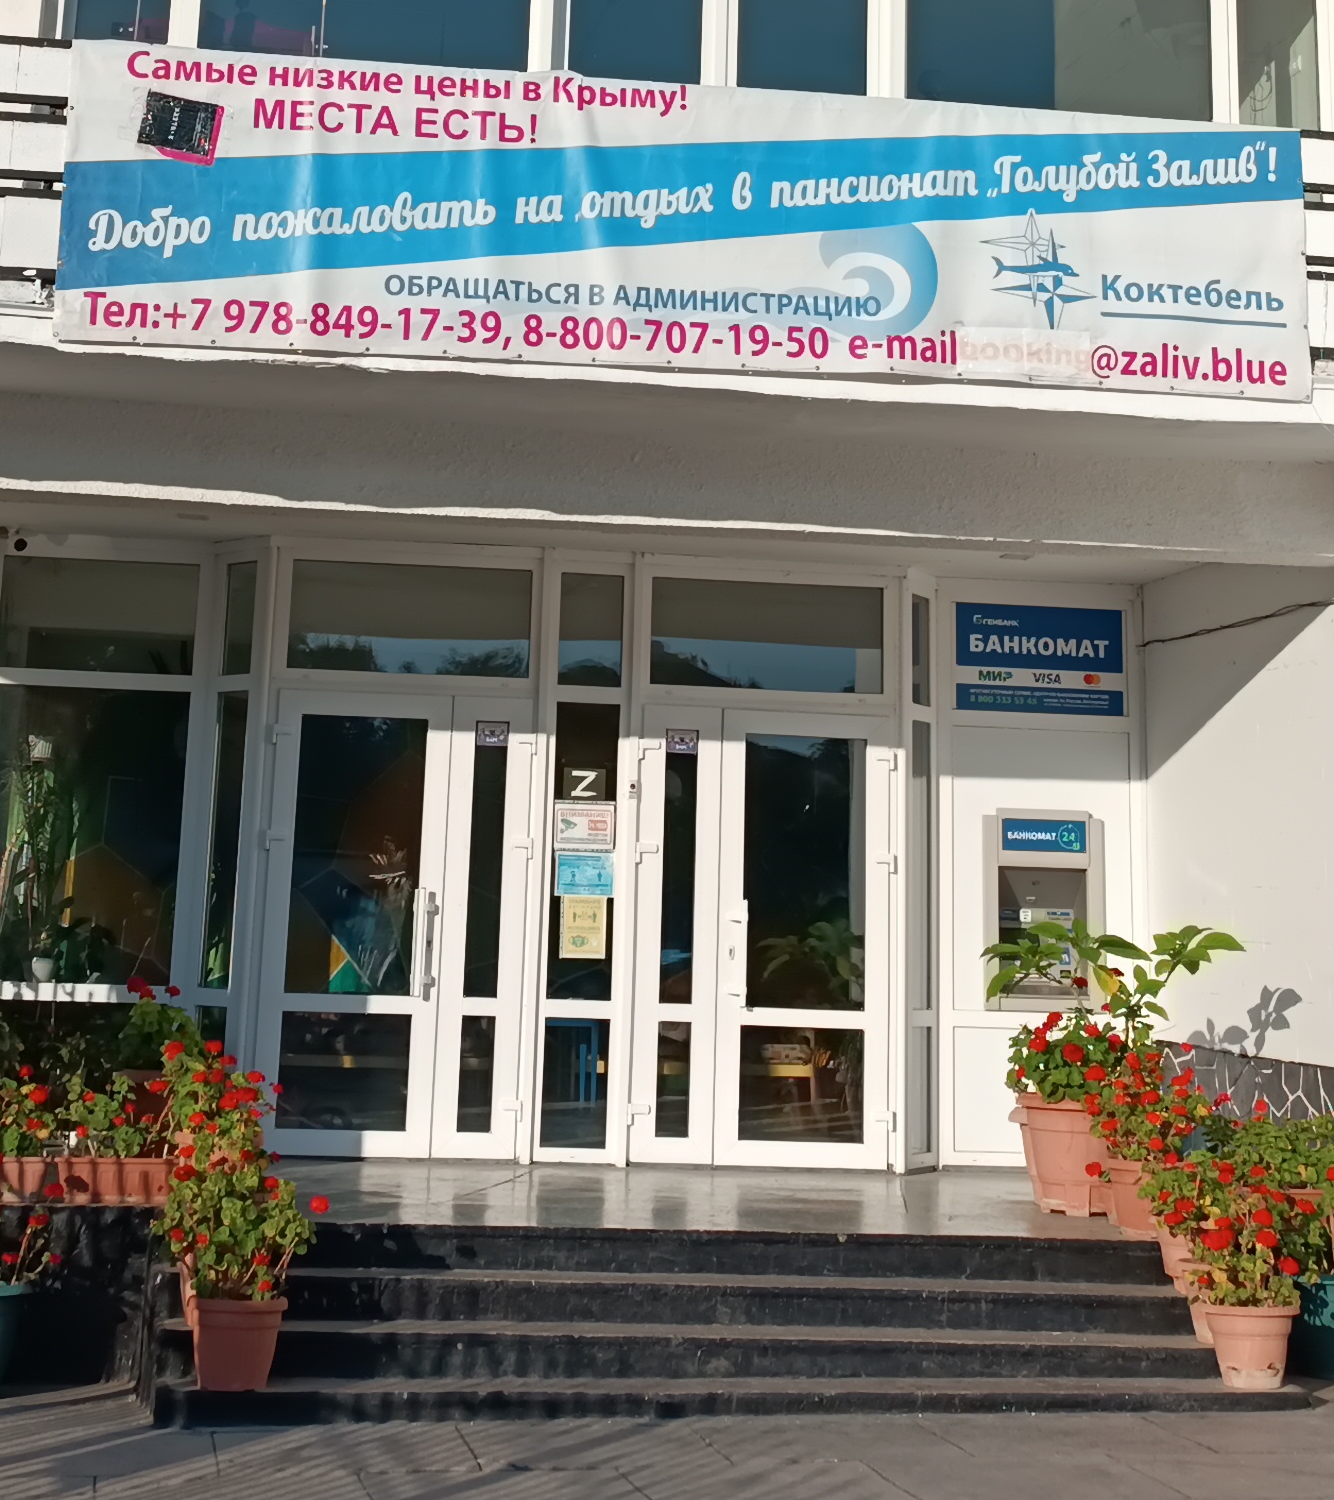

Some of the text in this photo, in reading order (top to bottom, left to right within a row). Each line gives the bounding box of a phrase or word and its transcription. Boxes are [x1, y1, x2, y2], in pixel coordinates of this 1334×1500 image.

[127, 51, 687, 116] Самые низкие цены в Крыму!
[254, 98, 538, 143] МЕСТА ЕСТЬ!
[88, 205, 211, 257] Добро
[233, 191, 496, 241] пожаловать
[515, 195, 563, 225] на
[580, 184, 713, 228] отдых
[731, 171, 753, 211] в
[771, 171, 978, 208] пансионат
[384, 274, 880, 319] ОБРАЩАТЬСЯ В АДМИНИСТРАЦИЮ
[1101, 274, 1284, 312] Коктебель
[84, 291, 213, 331] Тел:+7
[223, 300, 512, 350] 978-849-17-39,
[523, 316, 829, 360] 8-800-707-19-50
[848, 331, 958, 364] e-mail
[969, 633, 1110, 659] БАНКОМАТ
[978, 669, 1014, 682] МИР
[1032, 672, 1062, 685] VISA
[570, 769, 599, 798] Z
[1007, 831, 1076, 842] БАНКОМАТ 24
